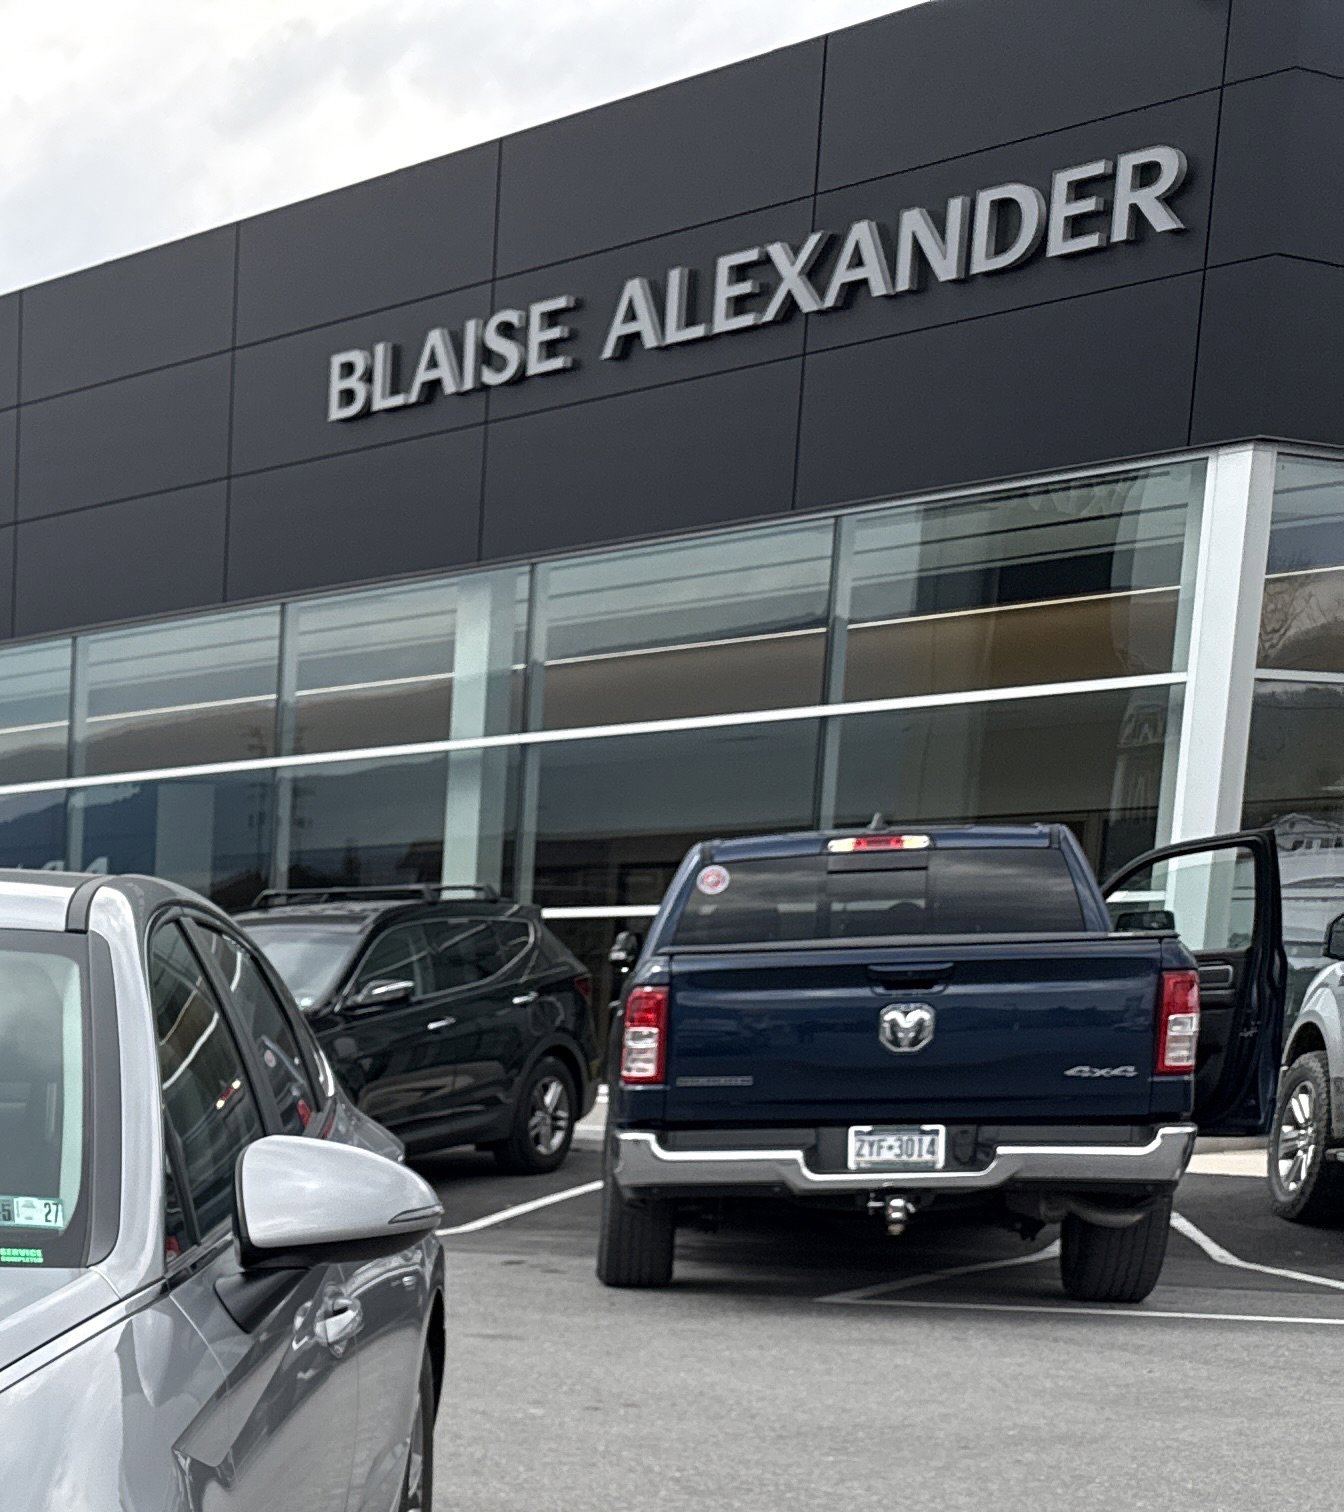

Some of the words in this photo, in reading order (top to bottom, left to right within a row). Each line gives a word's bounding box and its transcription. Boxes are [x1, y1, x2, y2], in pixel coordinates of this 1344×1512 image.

[327, 294, 575, 422] BLAISE
[601, 144, 1189, 360] ALEXANDER
[43, 1202, 61, 1224] 27
